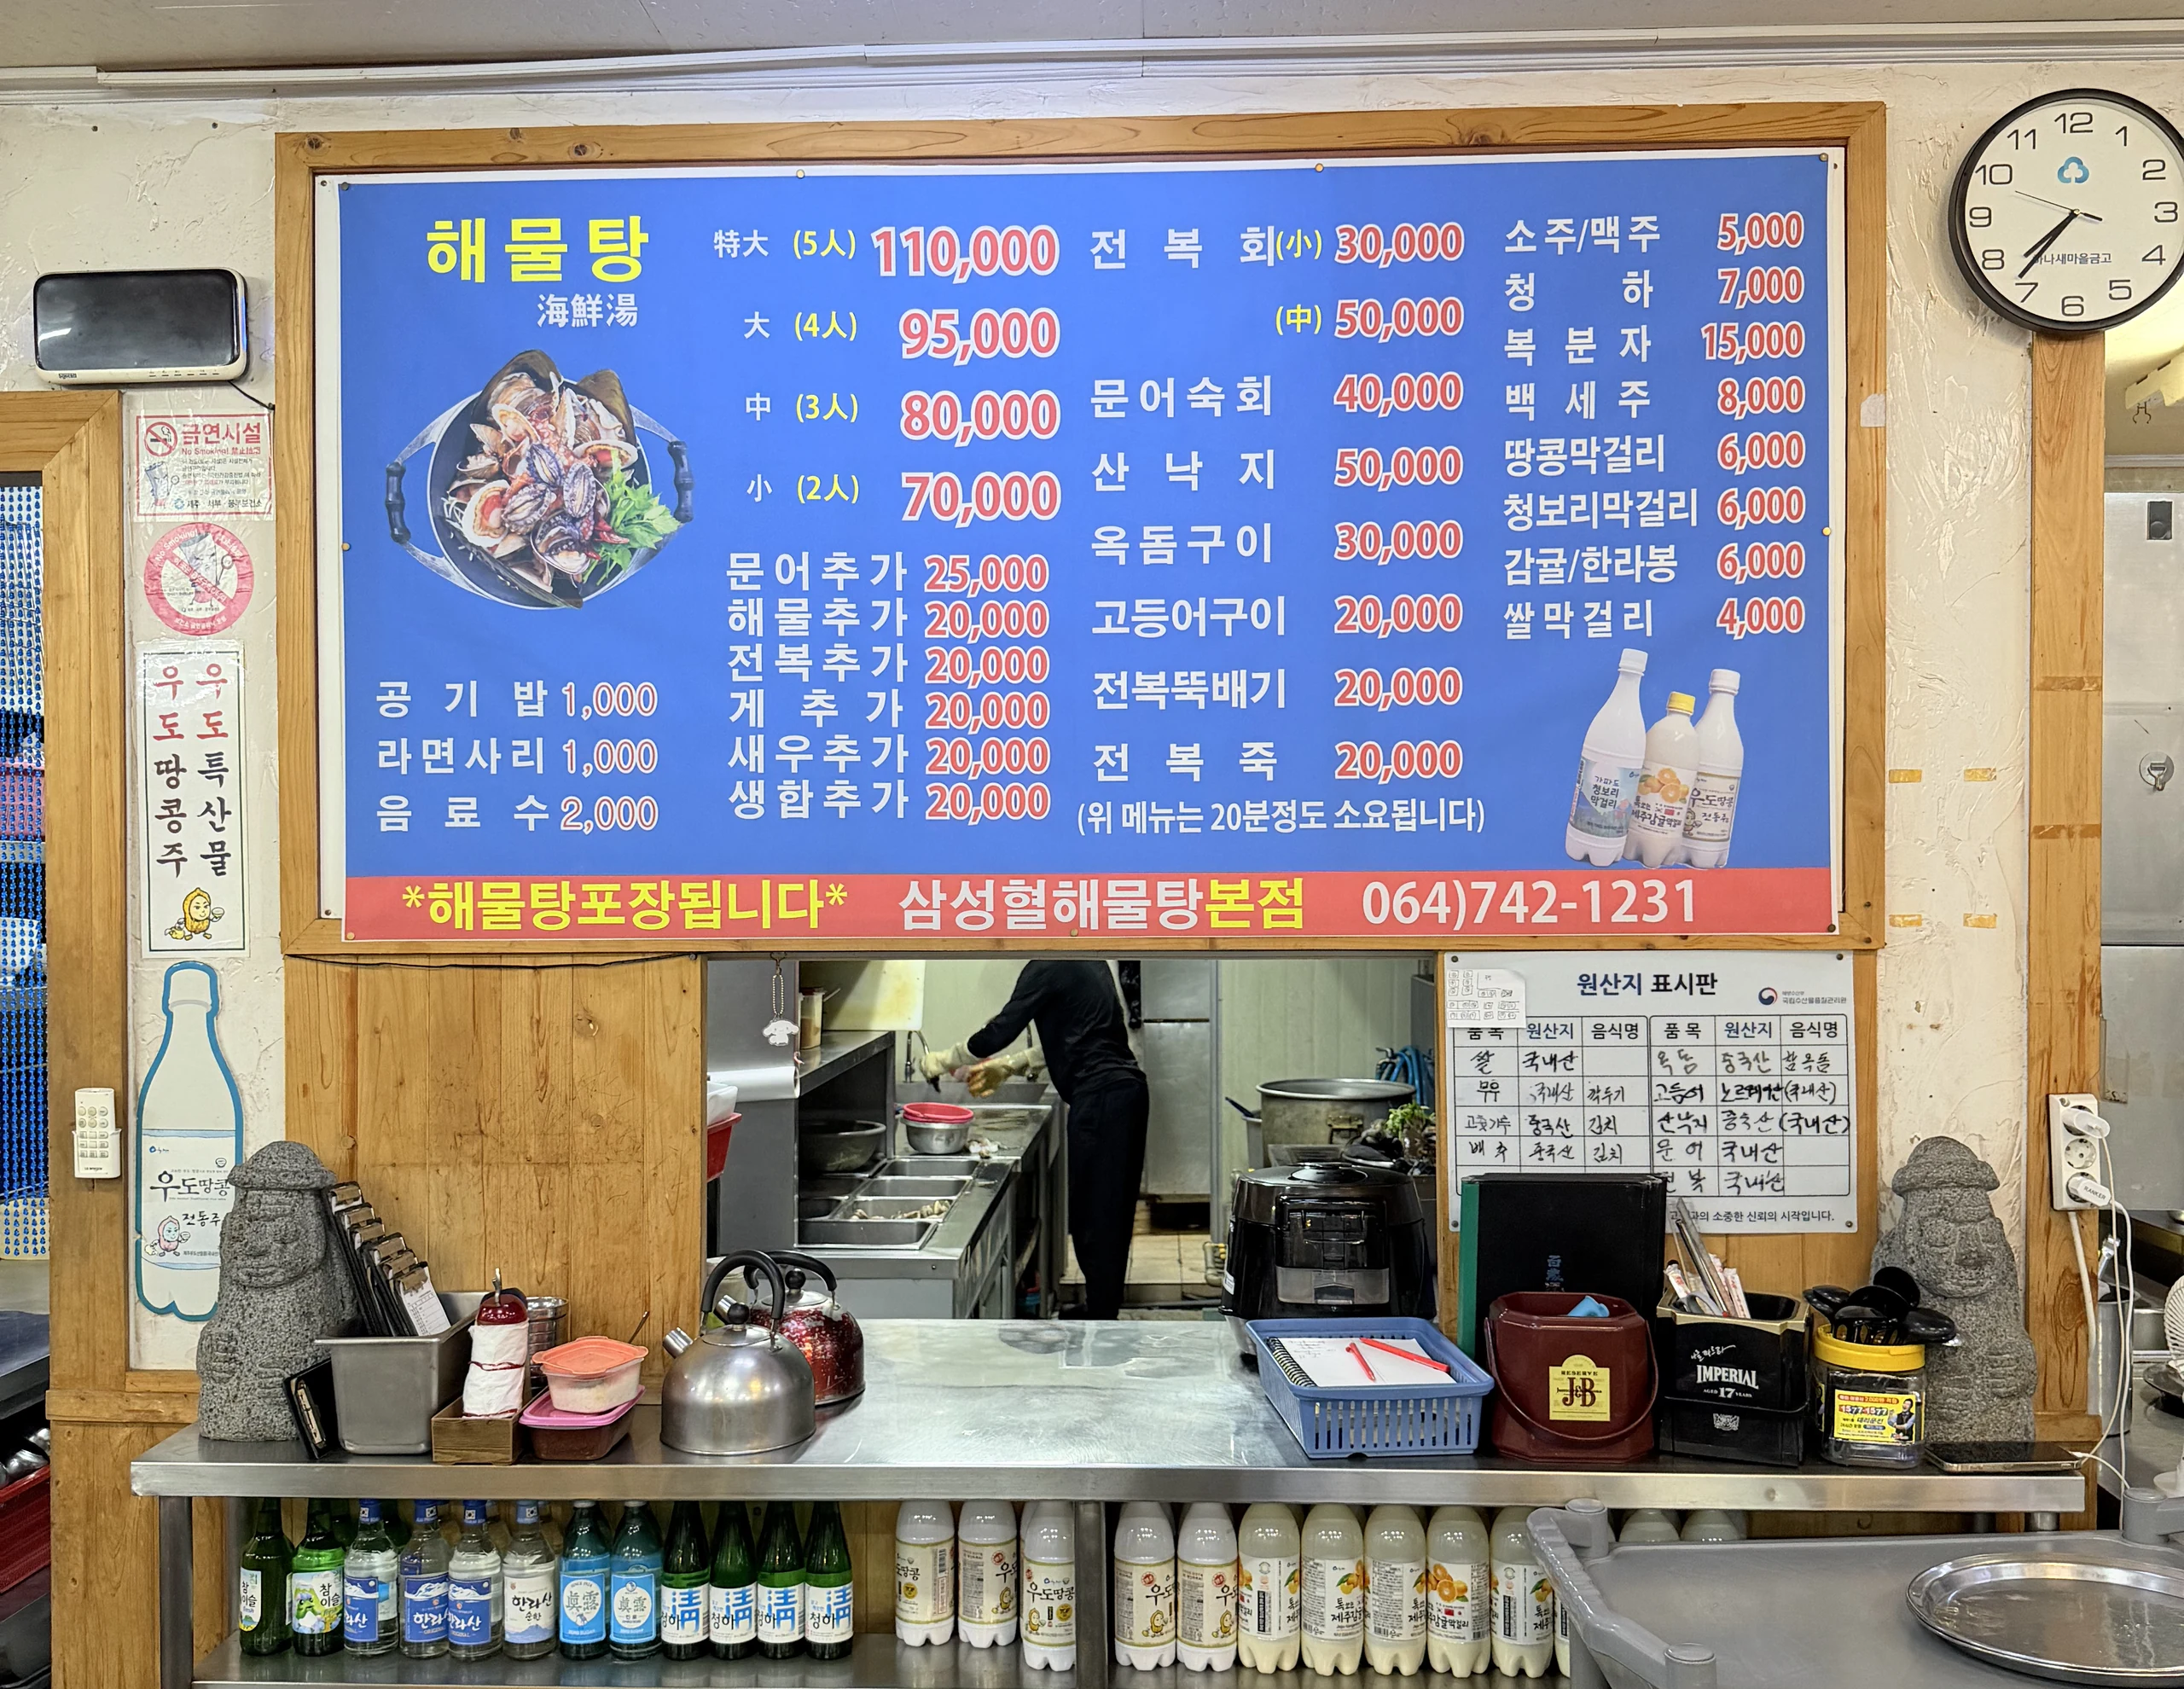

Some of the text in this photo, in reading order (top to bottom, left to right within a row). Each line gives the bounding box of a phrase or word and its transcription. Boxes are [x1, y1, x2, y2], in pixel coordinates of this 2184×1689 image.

[2007, 130, 2036, 149] 11
[2054, 113, 2093, 133] 12
[2116, 126, 2127, 146] 1
[1975, 164, 2013, 185] 10
[2143, 160, 2165, 180] 2
[1970, 207, 1991, 227] 9
[2155, 202, 2177, 222] 3
[426, 215, 648, 283] 해물탕
[1275, 229, 1321, 260] (小)
[1334, 222, 1464, 268] 30,000
[1505, 211, 1806, 255] 소주/맥주 5,000
[714, 225, 1060, 283] 特大 (5人) 110,000
[1982, 250, 2004, 270] 8
[2142, 246, 2165, 264] 4
[1717, 266, 1805, 309] 7,000
[2016, 283, 2038, 302] 7
[2062, 296, 2083, 316] 6
[2109, 280, 2131, 299] 5
[537, 294, 637, 328] 海鮮湯
[1275, 297, 1464, 343] (中) 50,000
[745, 308, 1060, 366] 大 (4人) 95,000
[1700, 321, 1806, 365] 15,000
[1091, 372, 1463, 418] 문어숙회 40,000
[1716, 375, 1806, 421] 8,000
[181, 422, 261, 444] 금연시설
[746, 390, 1060, 447] 中 (3人) 80,000
[1334, 446, 1463, 491] 50,000
[1505, 431, 1806, 477] 땅콩막걸리 6,000
[747, 471, 1061, 528] 小 (2人) 70,000
[1504, 485, 1806, 531] 청보리막걸리 6,000
[1092, 520, 1463, 566] 옥돔구이 30,000
[727, 552, 1049, 598] 문어추가 25,000
[1505, 541, 1806, 586] 감귤/한라봉 6,000
[728, 598, 1049, 643] 해물추가 20,000
[1092, 594, 1463, 639] 고등어구이 20,000
[1504, 596, 1805, 641] 쌀막걸리 4,000
[729, 643, 1049, 689] 전복추가 20,000
[562, 682, 657, 720] 1,000
[1094, 667, 1462, 712] 전복뚝배기 20,000
[925, 691, 1049, 735] 20,000
[154, 665, 188, 879] 우도땅콩주
[196, 662, 232, 877] 우도특산물
[379, 738, 657, 777] 라면사리 1,000
[729, 734, 1050, 780] 새우추가 20,000
[1334, 740, 1463, 785] 20,000
[729, 780, 1050, 826] 생합추가 20,000
[1590, 795, 1617, 809] 막걸리
[1592, 783, 1619, 798] 청보리
[561, 796, 658, 834] 2,000
[1078, 798, 1484, 835] (위 메뉴는 20분정도 소요됩니다)
[1363, 879, 1695, 925] 064)742-1231
[1577, 972, 1718, 996] 원산지 표시판
[1526, 1023, 1574, 1040] 원산지
[1591, 1023, 1639, 1040] 음식명
[1664, 1023, 1701, 1039] 품목
[1724, 1022, 1772, 1038] 원산지
[1790, 1021, 1838, 1038] 음식명
[1522, 1050, 1578, 1072] 국내산
[1653, 1082, 1704, 1104] 고등어
[1589, 1115, 1618, 1135] 김치
[1780, 1112, 1850, 1135] (국내산)
[1594, 1143, 1623, 1164] 김치
[1722, 1141, 1783, 1164] 국내산
[149, 1170, 230, 1203] 우도땅콩
[183, 1211, 221, 1227] 전통주
[1670, 1210, 1834, 1222] 고과의 소중한 신뢰의 시작입니다.
[1562, 1378, 1596, 1407] J&B
[1696, 1365, 1759, 1390] IMPERIAL
[1719, 1387, 1735, 1398] 17
[1839, 1405, 1888, 1415] 1577-1577
[512, 1592, 553, 1611] 한라산
[1026, 1582, 1075, 1603] 우도땅콩
[712, 1613, 736, 1630] 청하
[810, 1612, 836, 1629] 청하
